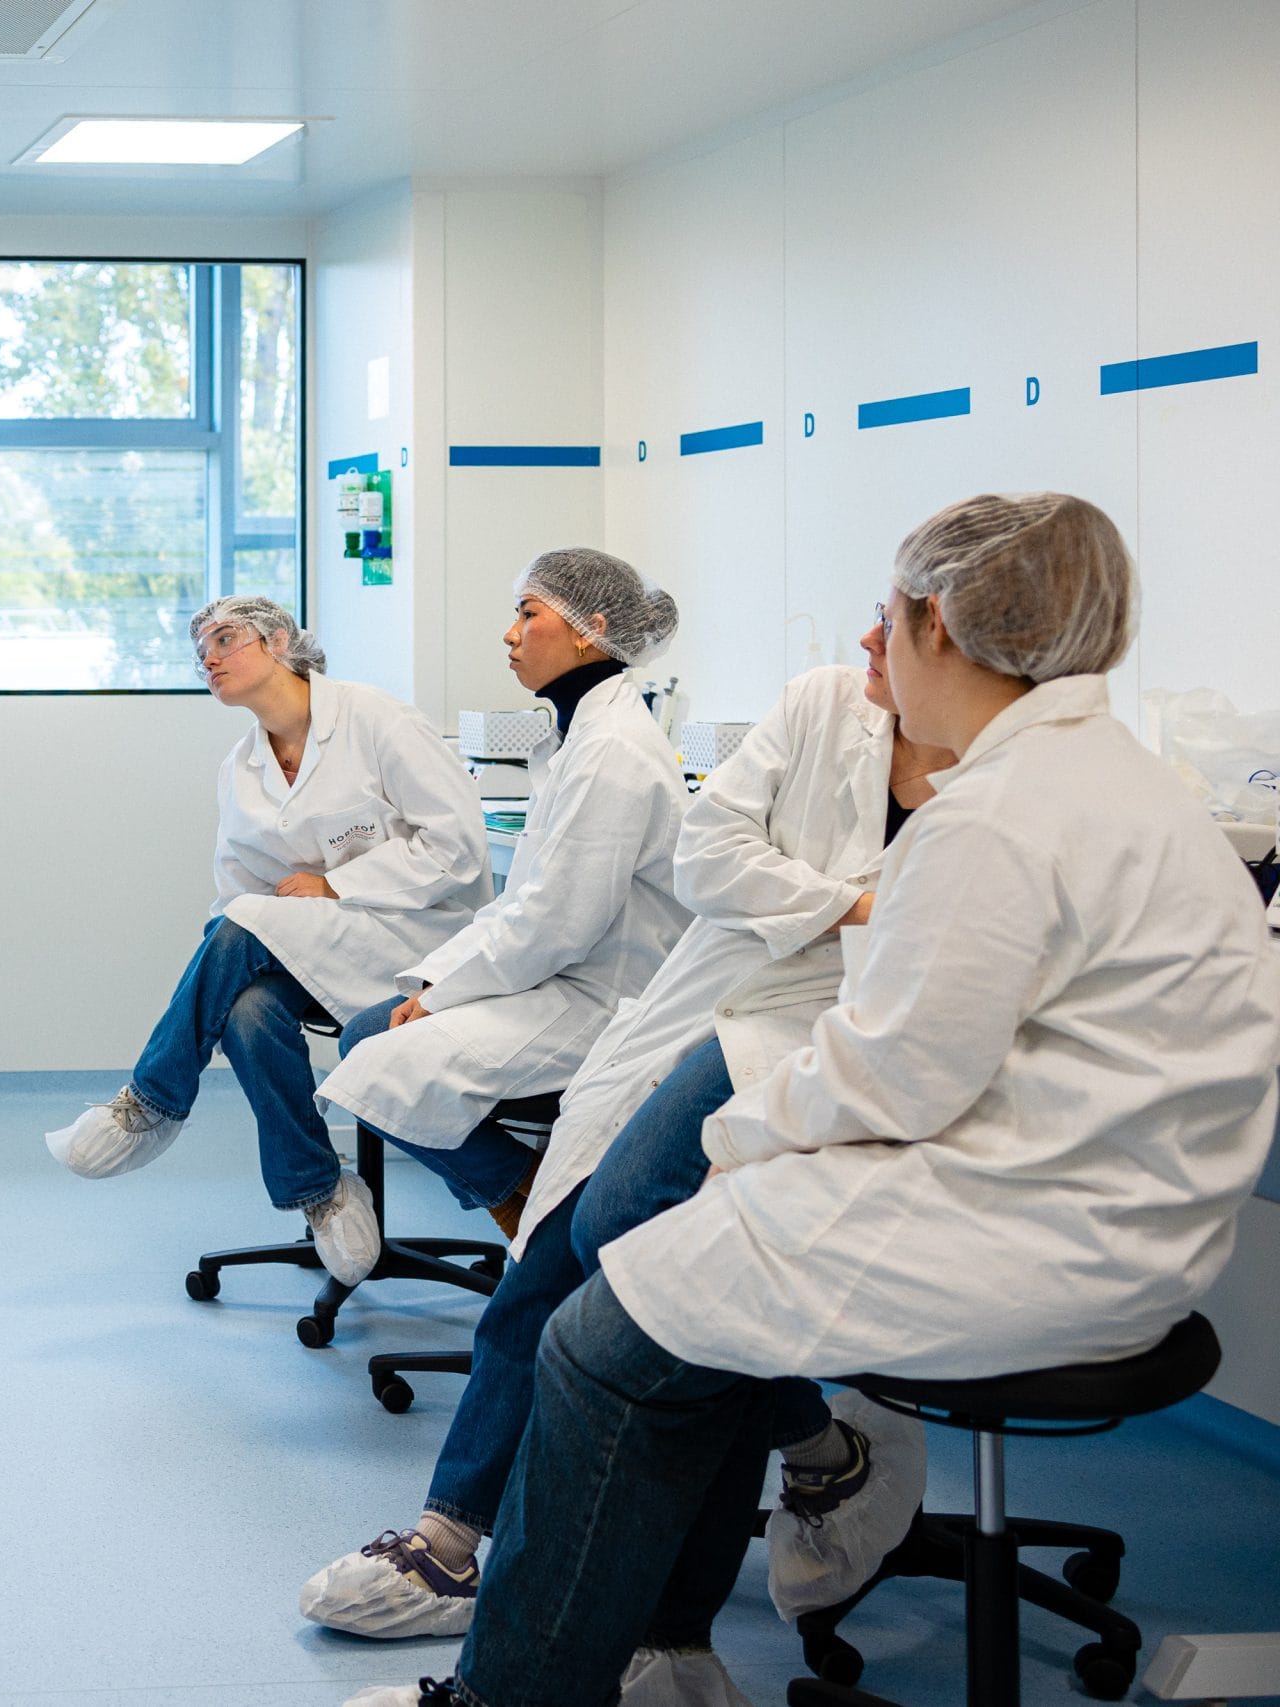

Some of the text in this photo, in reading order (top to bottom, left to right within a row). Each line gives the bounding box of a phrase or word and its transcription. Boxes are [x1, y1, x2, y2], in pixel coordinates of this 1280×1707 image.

[1026, 376, 1040, 406] D
[804, 413, 815, 438] D
[401, 447, 408, 467] D
[638, 441, 647, 462] D
